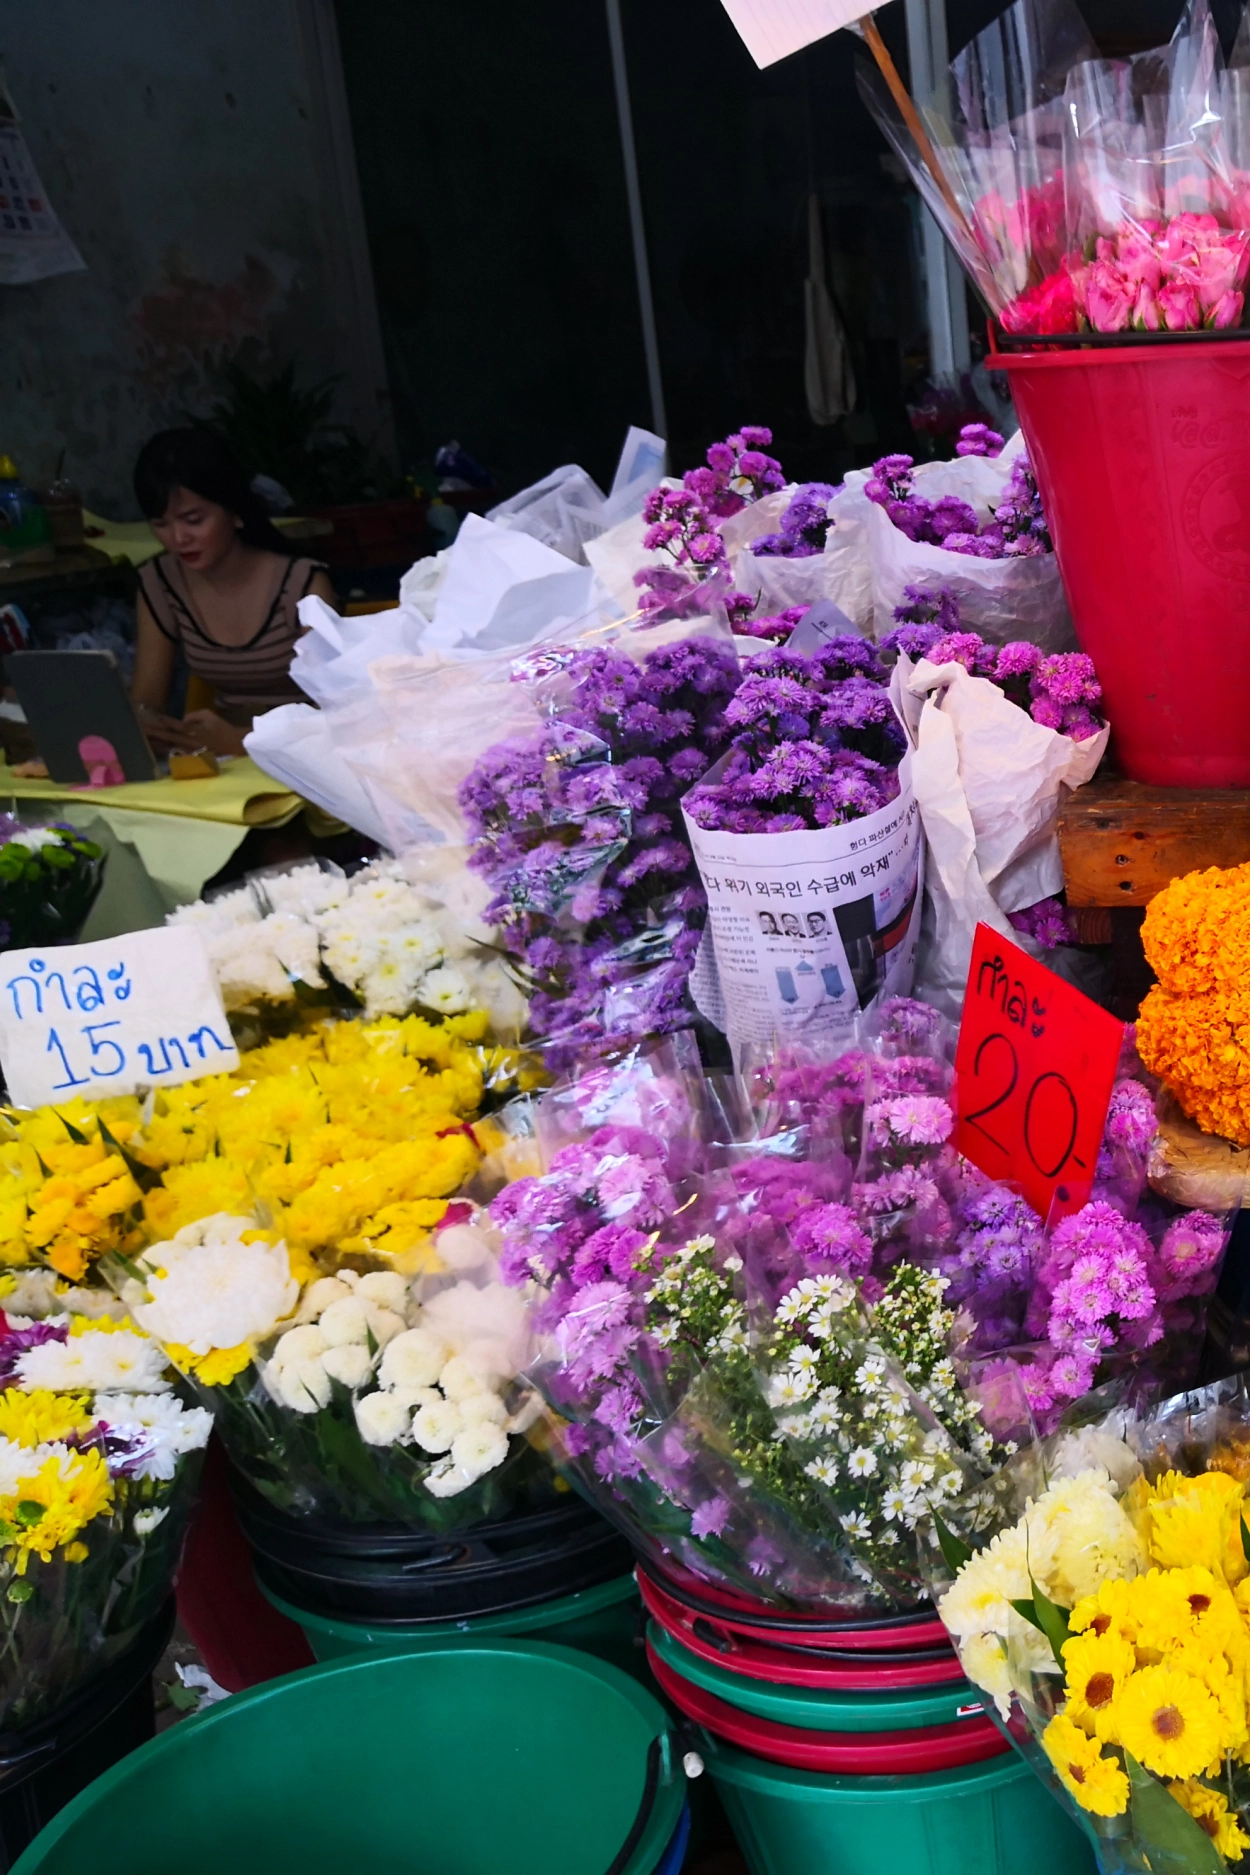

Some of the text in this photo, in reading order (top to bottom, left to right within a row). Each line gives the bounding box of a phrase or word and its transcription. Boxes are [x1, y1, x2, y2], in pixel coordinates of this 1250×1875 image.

[701, 870, 721, 893] 다
[724, 878, 752, 896] 위기
[755, 880, 803, 898] 외국인
[807, 871, 857, 895] 수급에
[6, 958, 131, 1019] กำละ
[47, 1021, 236, 1089] 15 บาท
